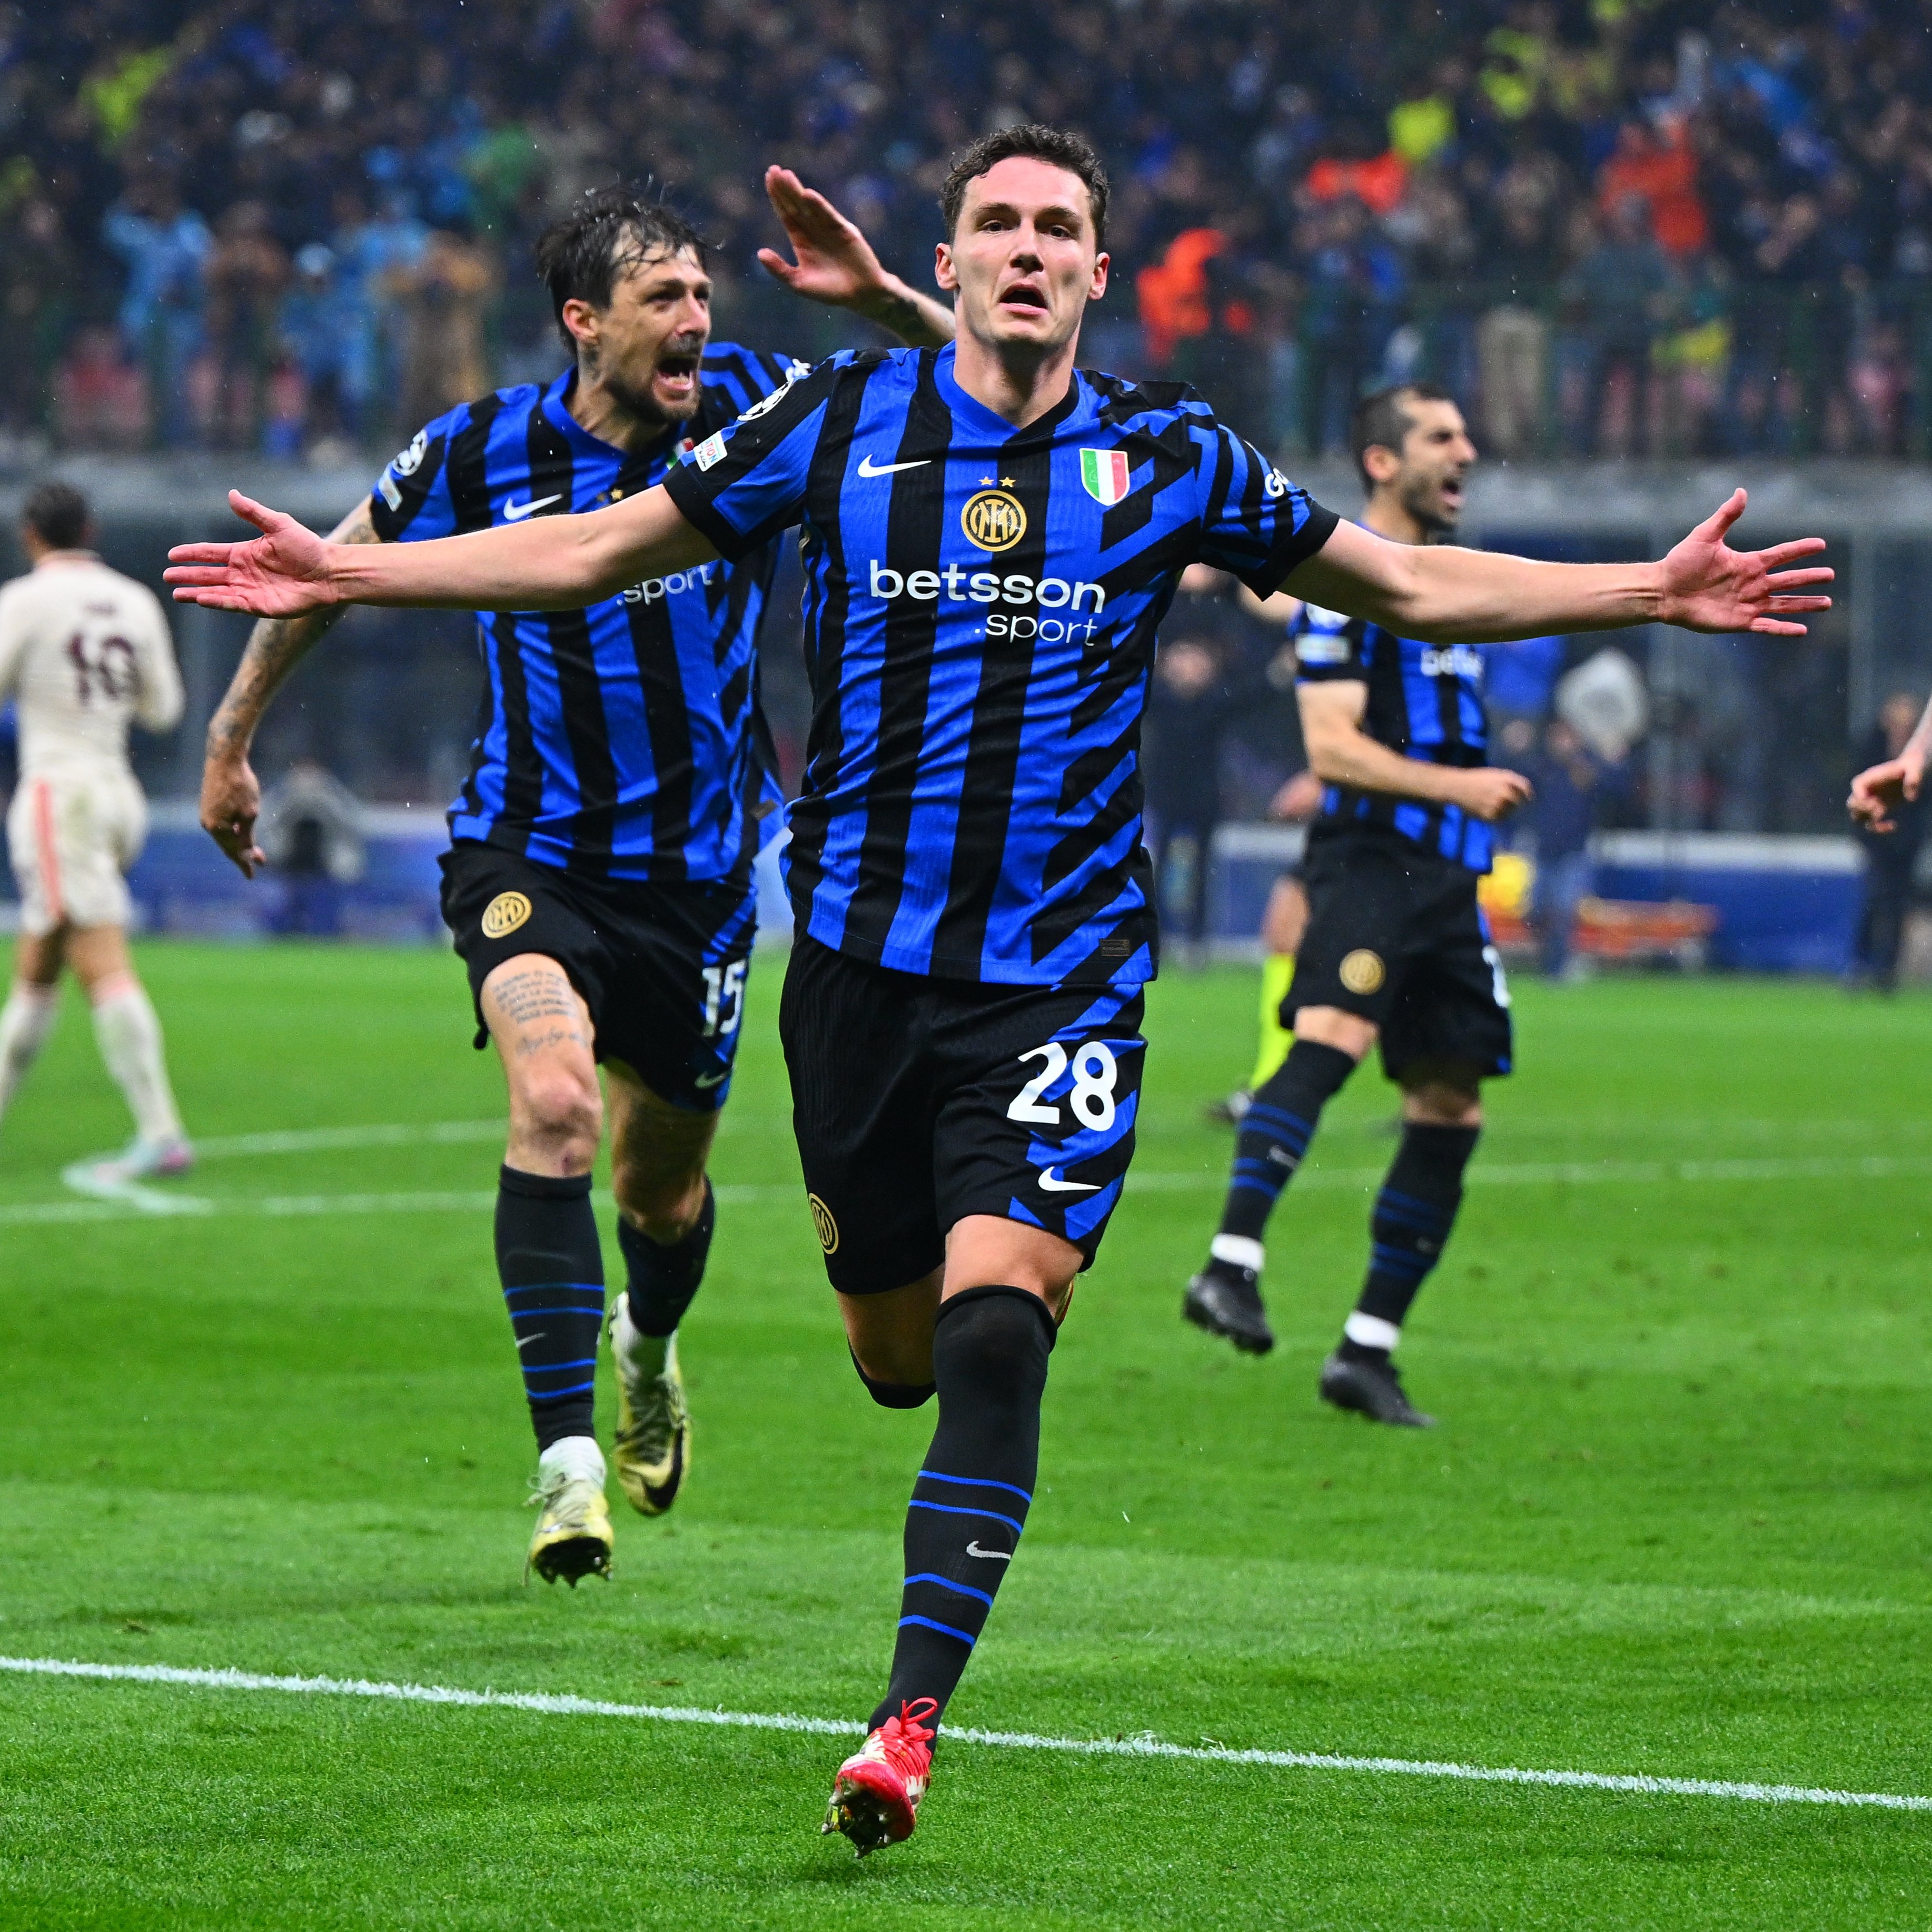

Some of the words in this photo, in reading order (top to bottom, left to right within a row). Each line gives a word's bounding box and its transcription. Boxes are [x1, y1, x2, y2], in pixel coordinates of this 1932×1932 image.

[870, 560, 1105, 614] betsson
[975, 614, 1098, 647] .sport
[702, 960, 746, 1036] 15
[1007, 1041, 1117, 1132] 28
